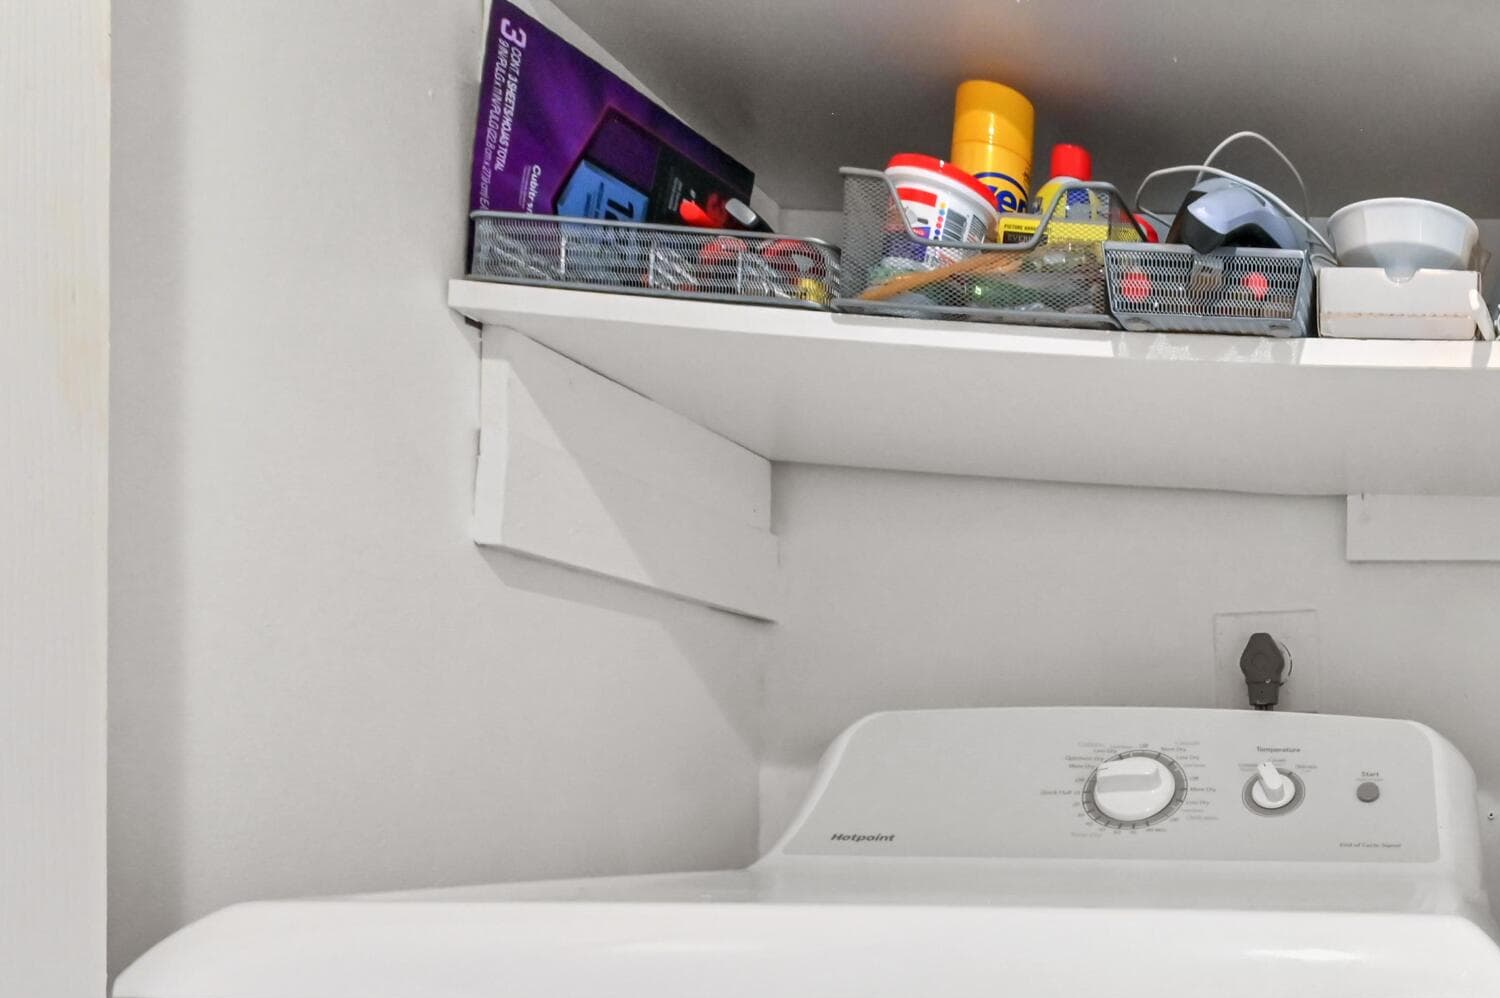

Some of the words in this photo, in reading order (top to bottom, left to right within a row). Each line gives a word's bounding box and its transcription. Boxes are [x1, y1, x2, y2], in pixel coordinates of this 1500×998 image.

[501, 17, 527, 49] 3
[494, 144, 508, 172] TOTAL
[1256, 745, 1301, 754] Temperature
[1361, 771, 1379, 779] Start
[831, 832, 896, 842] Hotpoint
